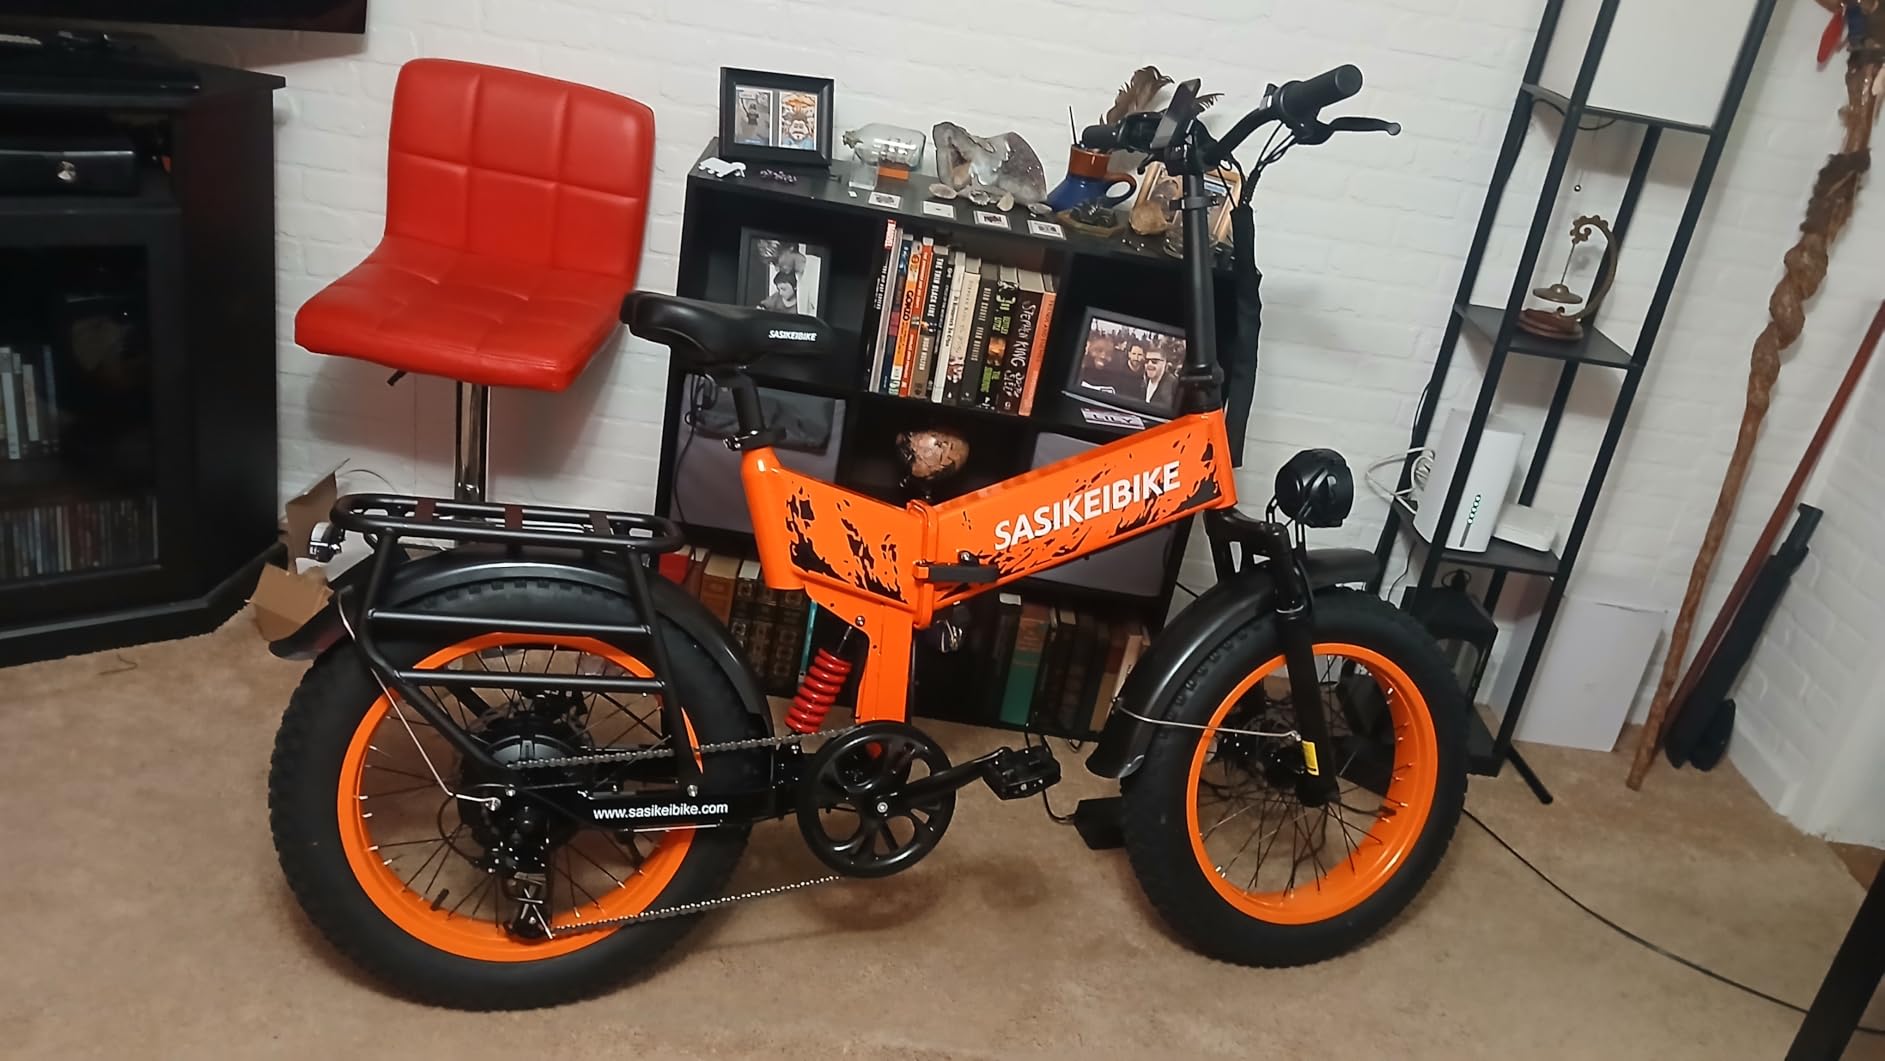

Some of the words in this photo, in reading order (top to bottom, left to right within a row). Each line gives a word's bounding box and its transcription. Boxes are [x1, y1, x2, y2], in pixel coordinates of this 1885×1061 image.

[935, 258, 944, 269] THE
[933, 270, 942, 284] THIN
[930, 284, 939, 303] BLACK
[903, 290, 914, 320] GONZO
[927, 304, 936, 317] LINE
[1019, 304, 1036, 338] STEPHEN
[768, 330, 817, 341] SASIKEIBIKE
[1010, 340, 1030, 367] KING
[993, 461, 1181, 551] SASIKEIBIKE
[593, 803, 729, 820] www.sasikeibike.com
